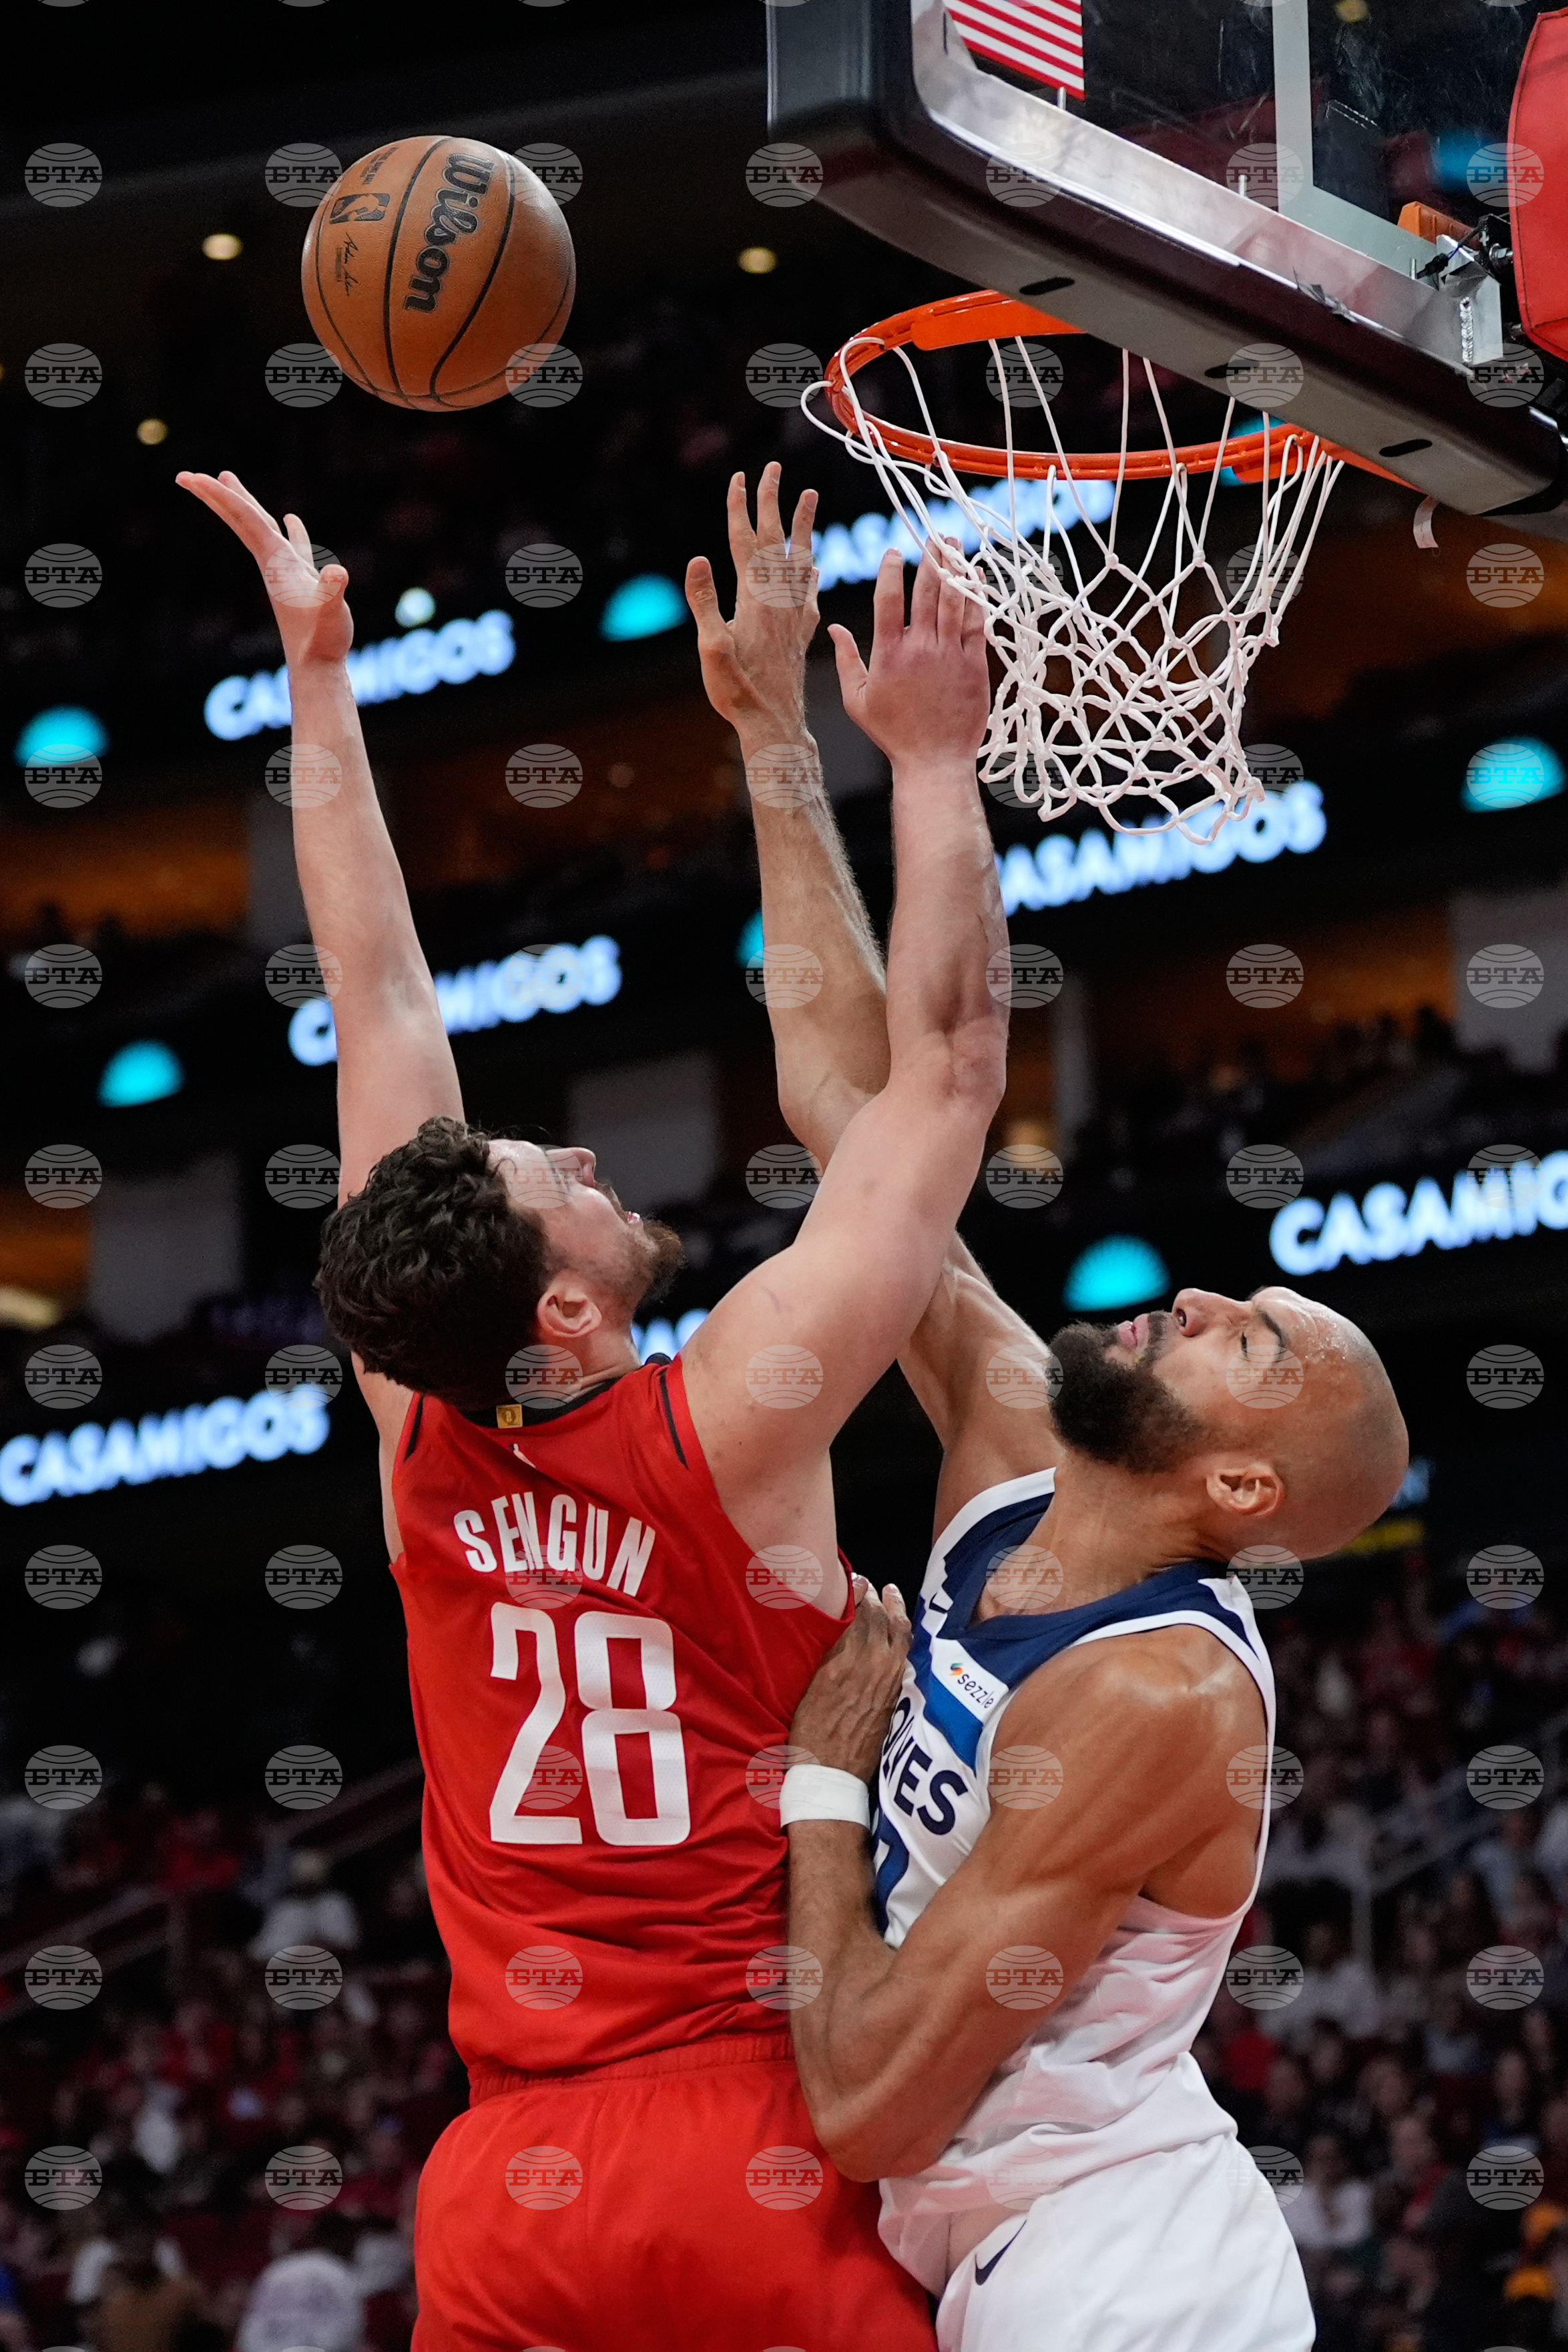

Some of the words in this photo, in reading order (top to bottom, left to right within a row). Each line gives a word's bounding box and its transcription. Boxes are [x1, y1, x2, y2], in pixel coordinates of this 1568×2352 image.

[404, 153, 495, 313] Wilson
[204, 608, 516, 741] CAMIGOS
[993, 779, 1327, 918] ASAMIGOS
[288, 935, 623, 1066] CMIGOS
[0, 1382, 330, 1507] CASAMIGOS
[454, 1491, 656, 1597] SENGUN
[489, 1601, 691, 1846] 28
[957, 1674, 995, 1709] sezzle
